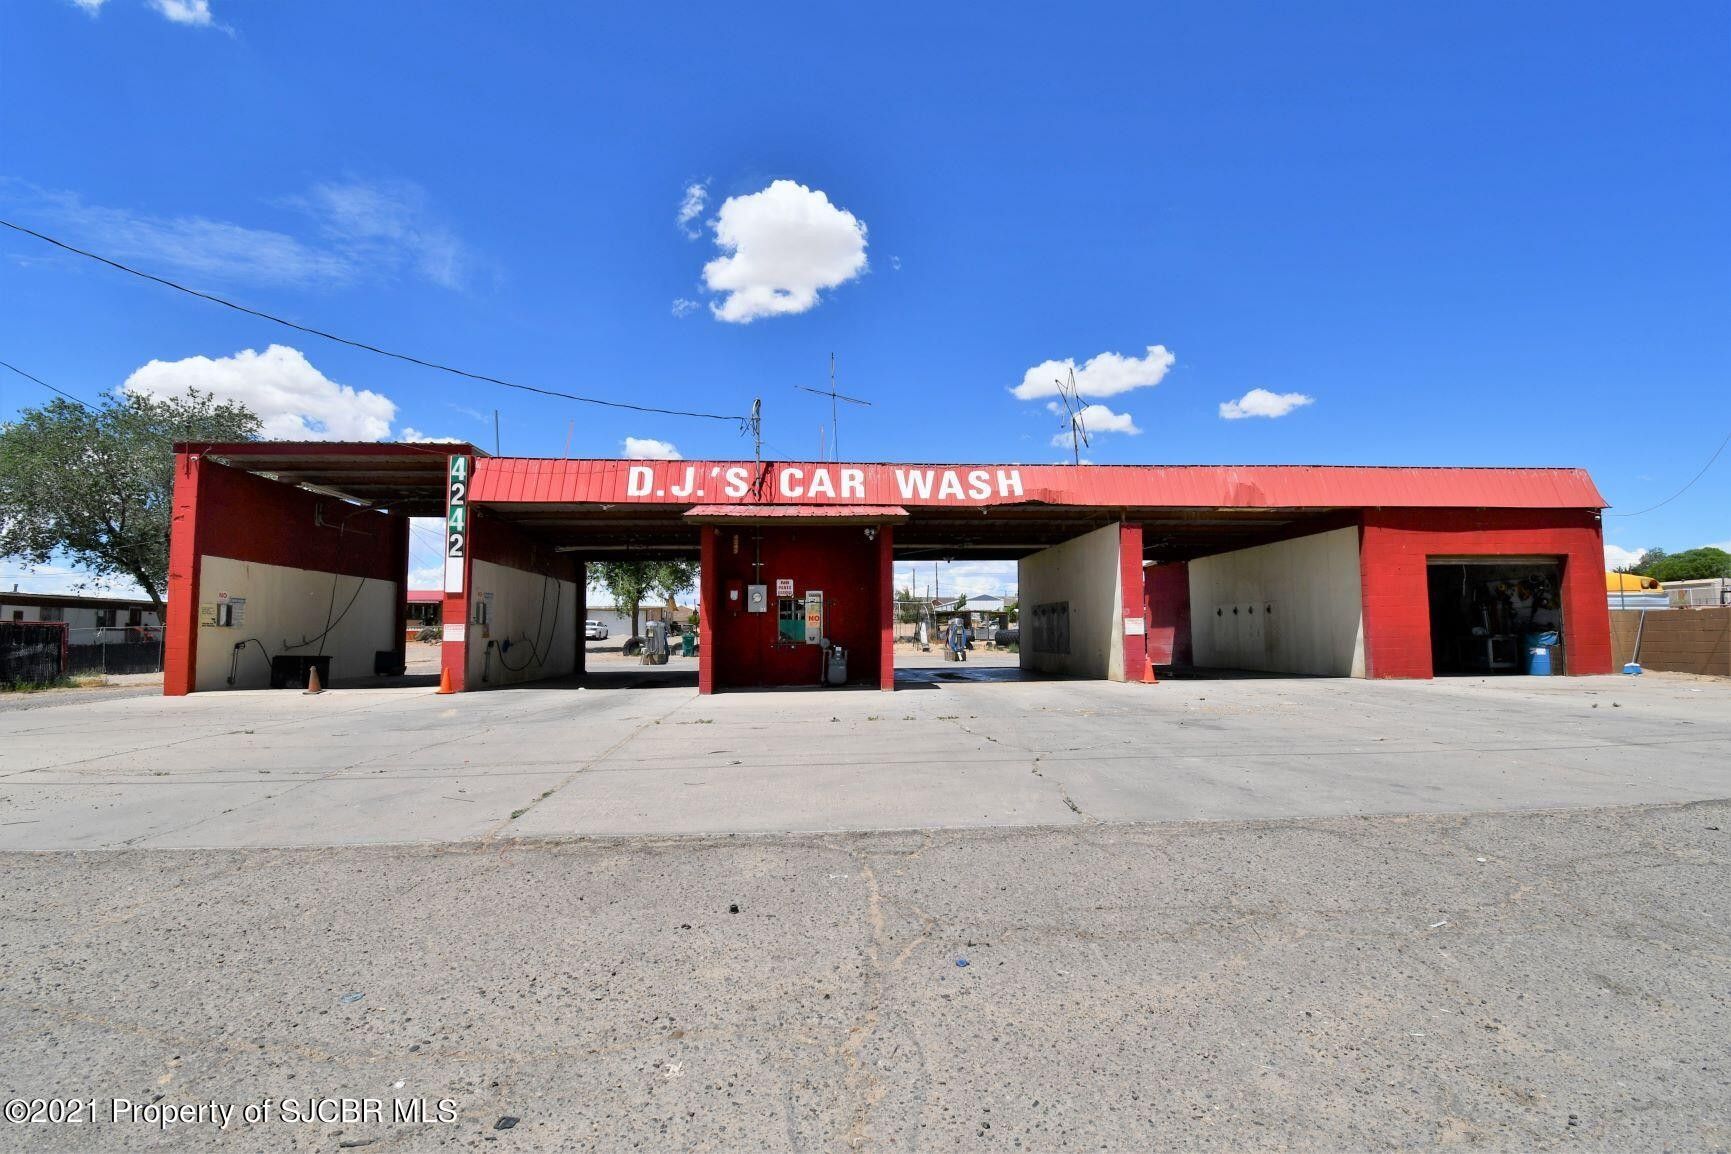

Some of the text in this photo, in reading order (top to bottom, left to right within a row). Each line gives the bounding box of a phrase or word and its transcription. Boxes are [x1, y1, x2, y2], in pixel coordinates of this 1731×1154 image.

[449, 457, 466, 556] 4242
[627, 466, 1024, 499] D.J.'S CAR WASH
